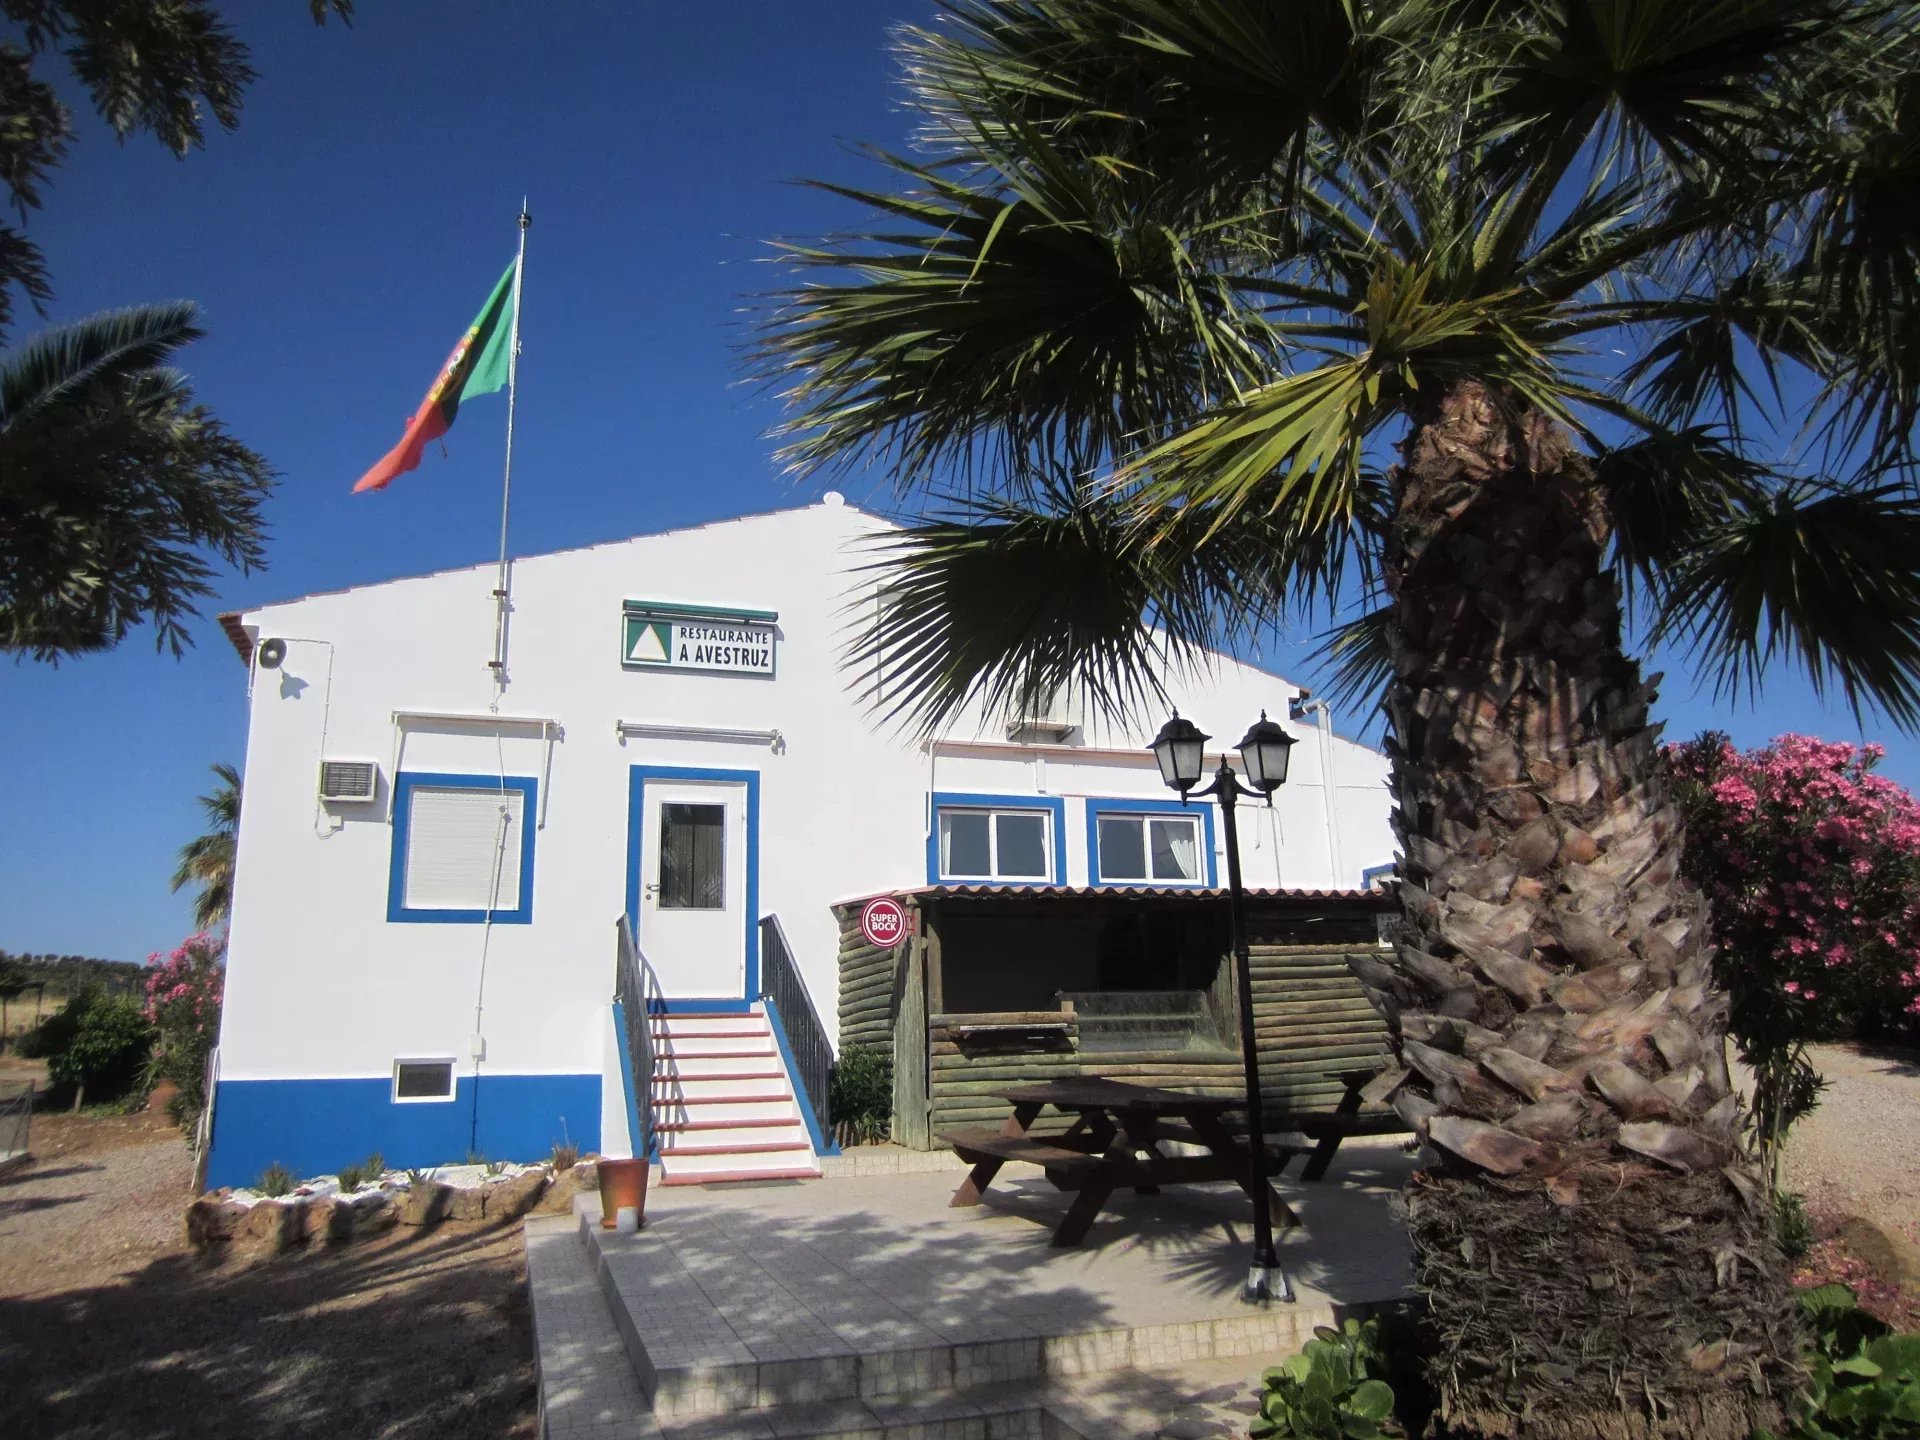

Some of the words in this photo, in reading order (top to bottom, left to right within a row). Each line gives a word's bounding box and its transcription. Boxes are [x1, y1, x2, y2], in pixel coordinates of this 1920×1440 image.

[680, 627, 768, 644] RESTAURANTE
[679, 644, 689, 662] A
[695, 644, 769, 667] AVESTRUZ
[870, 913, 898, 923] SUPER
[872, 921, 897, 931] BOCK
